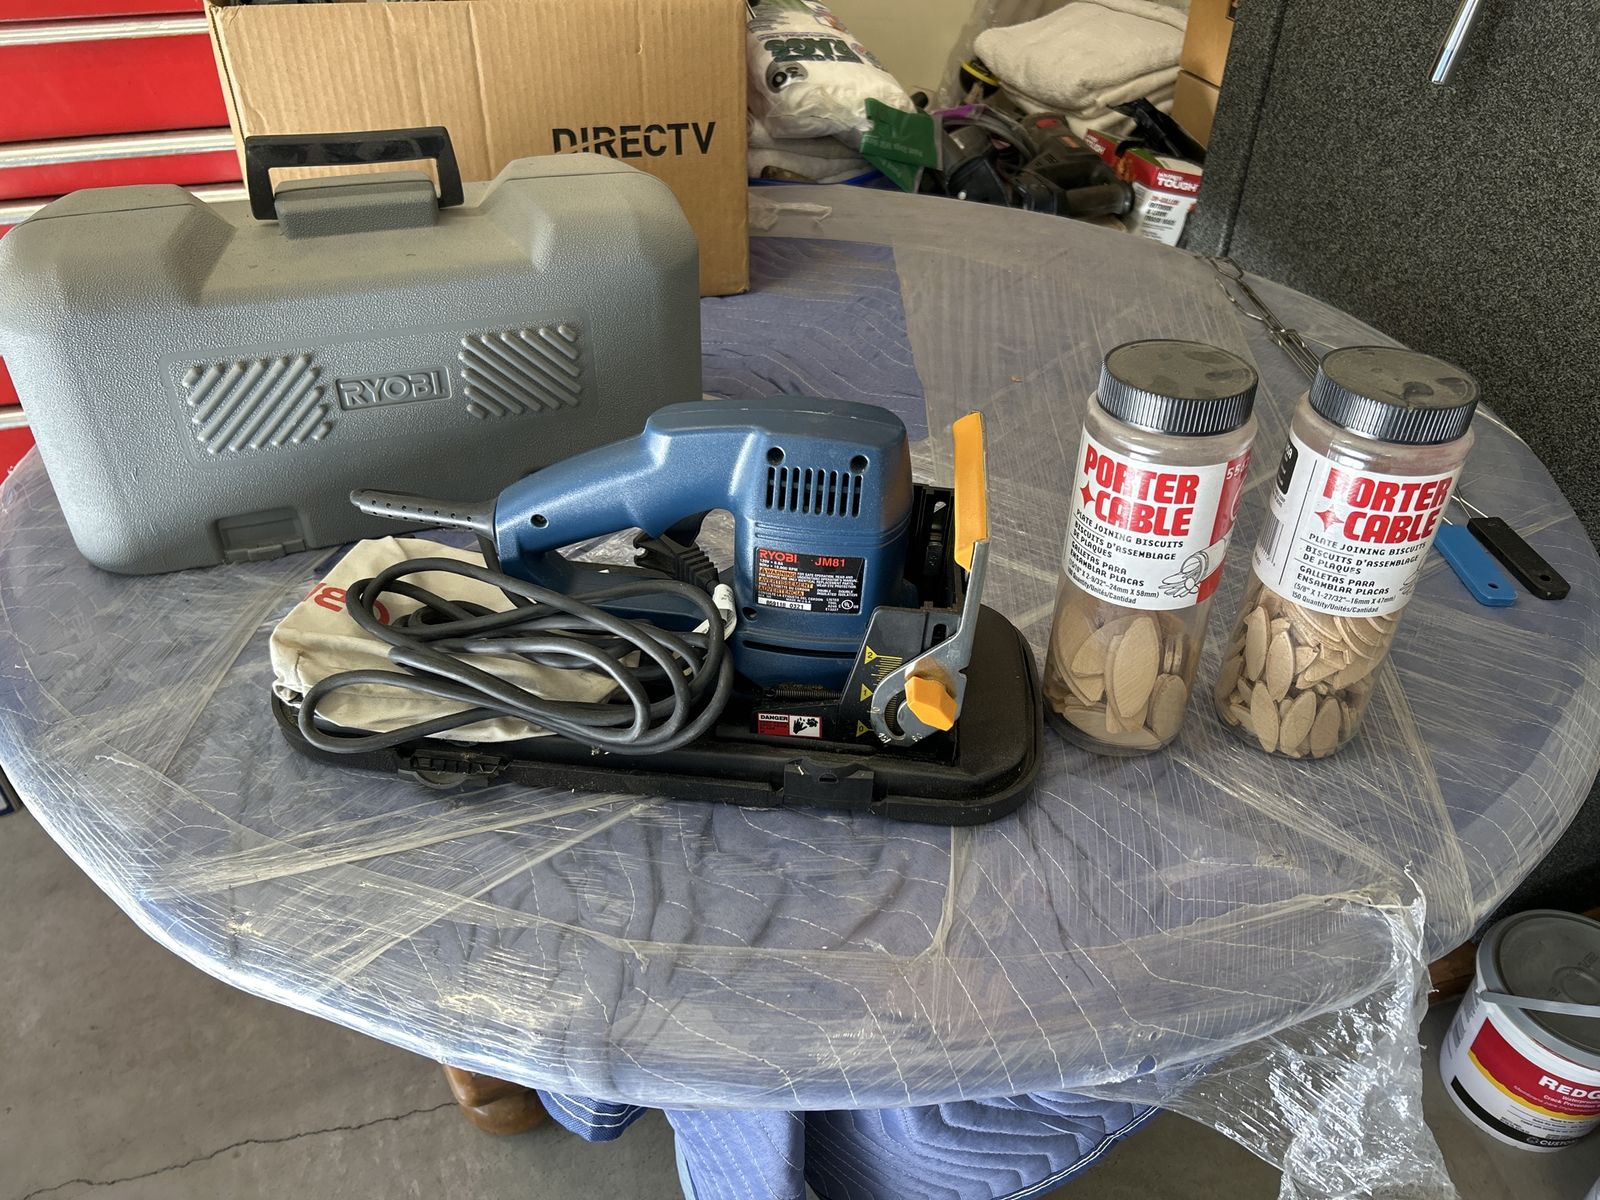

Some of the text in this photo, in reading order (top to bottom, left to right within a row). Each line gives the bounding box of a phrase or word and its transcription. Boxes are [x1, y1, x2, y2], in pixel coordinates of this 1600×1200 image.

[552, 121, 717, 159] DIRECTV
[1157, 178, 1199, 192] TOUGH
[340, 371, 442, 407] RYOBI
[1083, 444, 1200, 505] PORTER
[1323, 467, 1454, 513] PORTER
[1076, 508, 1184, 548] PLATE JOINING BISCUITS
[1094, 490, 1194, 537] CABLE
[1343, 509, 1442, 544] CABLE
[1073, 529, 1113, 558] DE PLAQUES
[1074, 520, 1177, 560] BISCUITS D'ASSEMBLAGE
[1308, 533, 1426, 556] PLATE JOINING BISCUITS
[759, 549, 846, 568] RYOBI JM81
[1070, 548, 1107, 578] ENSAMBLAR
[1109, 573, 1145, 587] PLACAS
[1071, 541, 1127, 575] GALLETAS PARA
[1302, 553, 1362, 575] DE PLAQUES
[1305, 545, 1419, 568] BISCUITS D'ASSEMBLAGE
[766, 569, 796, 578] WARNING
[1297, 573, 1390, 596] ENSAMBLAR PLACAS
[1300, 565, 1376, 588] GALLETAS PARA
[868, 651, 873, 659] 2
